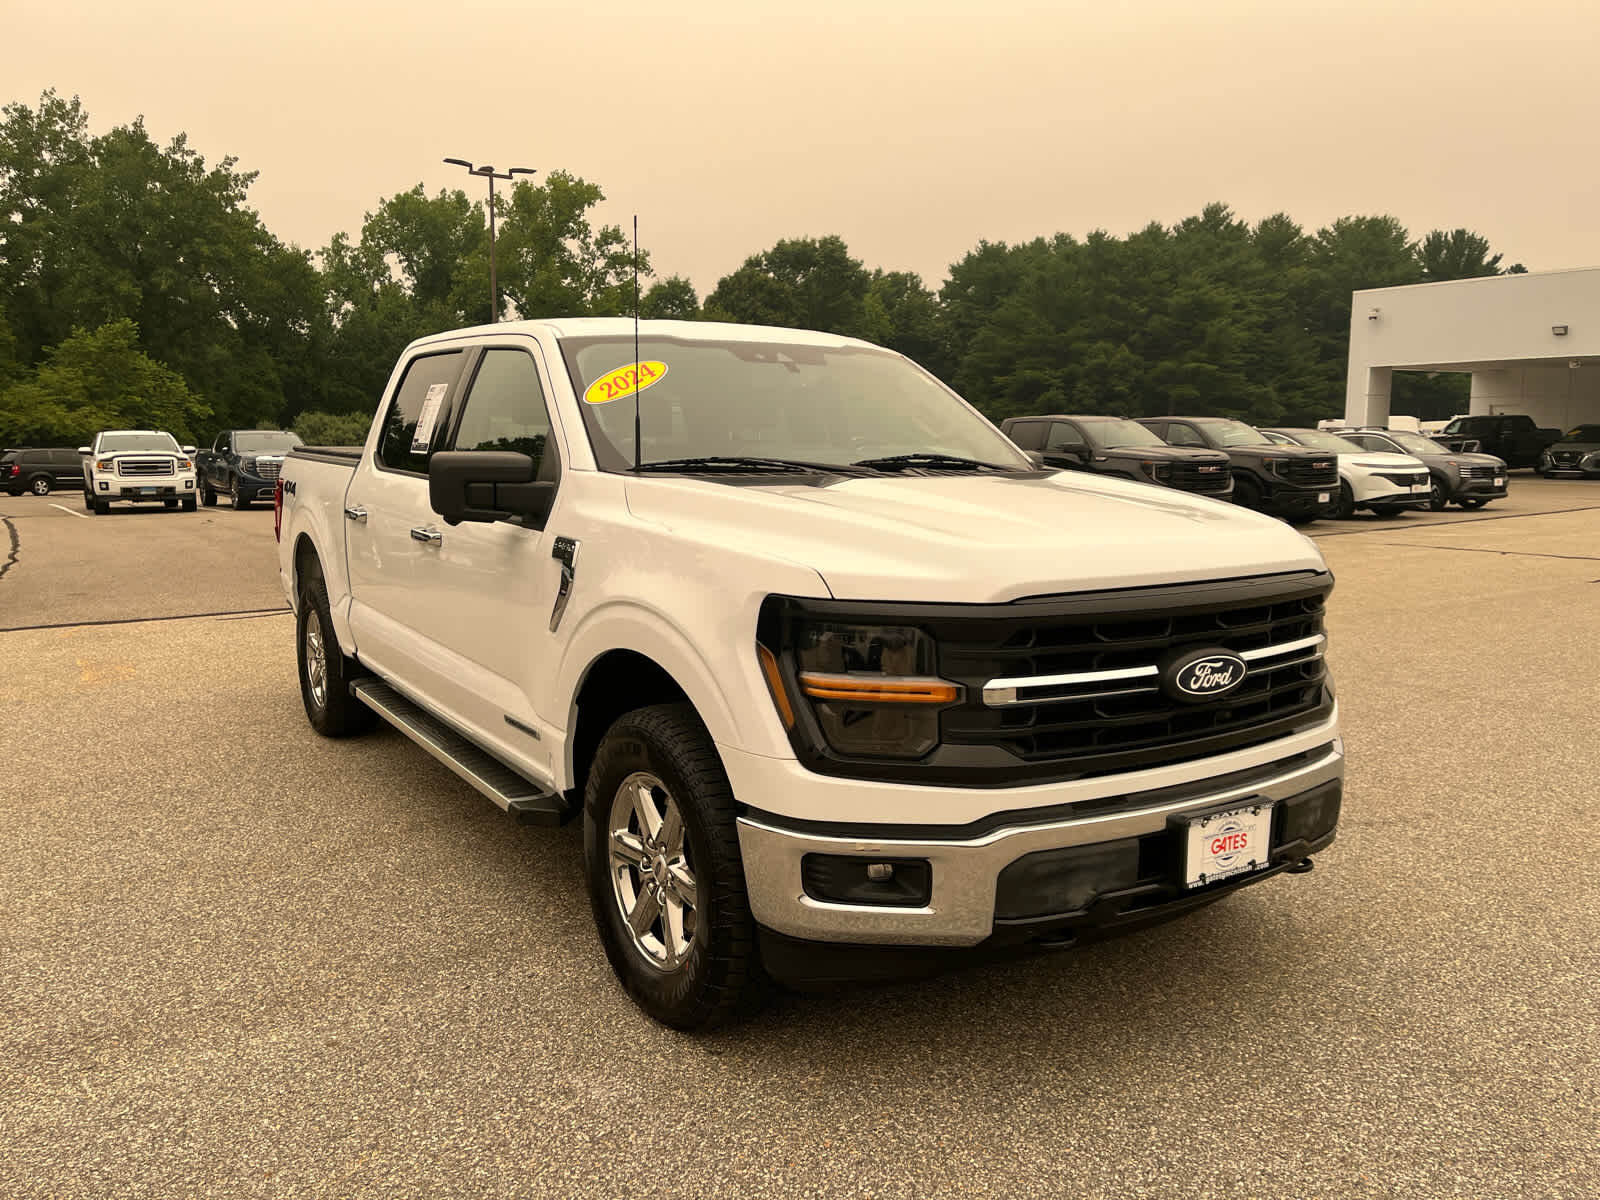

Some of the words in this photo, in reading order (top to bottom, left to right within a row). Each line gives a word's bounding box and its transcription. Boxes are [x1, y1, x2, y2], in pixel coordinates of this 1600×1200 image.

[599, 364, 656, 398] 2024
[1190, 661, 1234, 690] Ford
[1210, 832, 1248, 855] GATES
